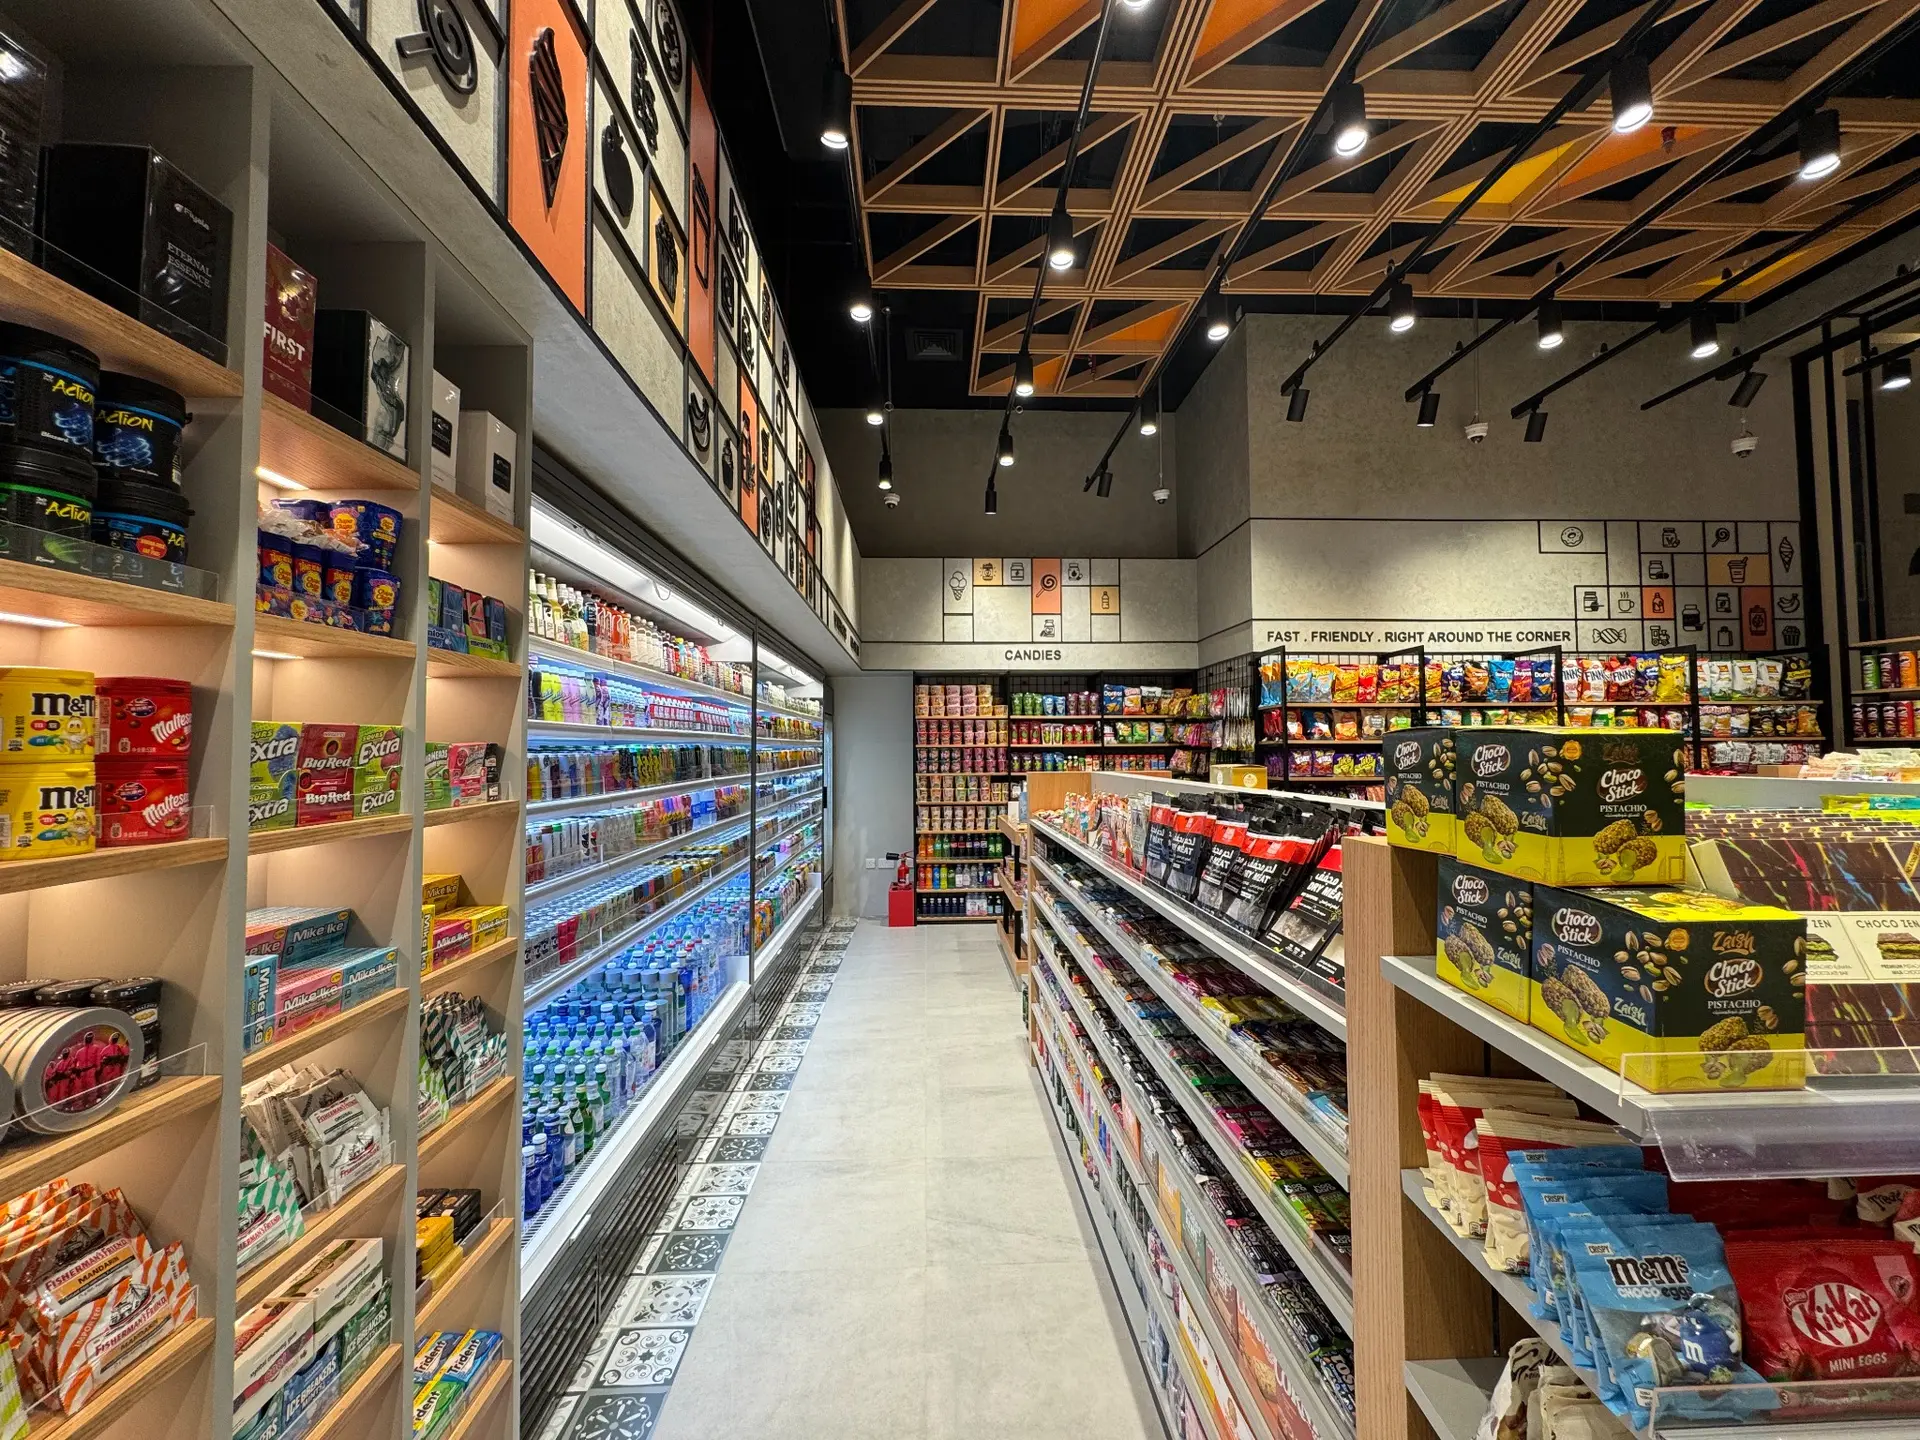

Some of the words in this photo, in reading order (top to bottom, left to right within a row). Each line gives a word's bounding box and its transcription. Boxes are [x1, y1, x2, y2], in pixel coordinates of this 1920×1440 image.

[167, 241, 212, 277] ETERNAL
[167, 254, 212, 288] ESSENCE
[263, 320, 305, 362] FIRST
[1267, 631, 1300, 643] FAST
[1311, 631, 1375, 643] FRIENDLY
[1385, 631, 1424, 643] RIGHT
[1428, 631, 1484, 643] AROUND
[1487, 631, 1512, 643] THE
[1516, 630, 1571, 643] CORNER
[1004, 649, 1062, 661] CANDIES
[1612, 669, 1636, 681] FINNS
[358, 737, 401, 766] Extra
[1397, 741, 1418, 758] Choco
[1475, 744, 1506, 764] Choco
[1397, 754, 1420, 771] Stick
[1477, 759, 1507, 778] Stick
[1398, 772, 1423, 780] PISTACHIO
[1476, 780, 1511, 791] PISTACHIO
[1600, 769, 1642, 788] Choco
[361, 789, 396, 814] Extra
[1605, 781, 1645, 802] Stick
[1600, 803, 1648, 813] PISTACHIO
[1252, 873, 1271, 885] MEAT
[1307, 881, 1323, 894] DRY
[1455, 875, 1485, 890] Choco
[1457, 889, 1485, 905] Stick
[1456, 906, 1488, 924] PISTACHIO
[1556, 907, 1597, 927] Choco
[1811, 919, 1832, 929] ZEN
[1856, 919, 1899, 929] CHOCO
[293, 926, 325, 943] Mike
[327, 921, 344, 934] Ike
[1559, 924, 1597, 944] Stick
[262, 940, 281, 954] Ike
[1711, 930, 1756, 956] Zaish
[1557, 944, 1601, 968] PISTACHIO
[349, 968, 377, 985] Mike
[1709, 959, 1756, 982] Choco
[257, 965, 272, 1013] Mike
[1713, 975, 1758, 998] Stick
[283, 991, 319, 1015] Mike
[1613, 997, 1647, 1027] Zaish
[1707, 1000, 1761, 1010] PISTACHIO
[1526, 1153, 1546, 1161] CRISPY
[1544, 1194, 1565, 1203] CRISPY
[1588, 1244, 1609, 1254] CRISPY
[45, 1251, 105, 1291] FISHERMAN'S
[102, 1237, 128, 1255] FRIEND
[77, 1255, 120, 1285] MANDARIN
[1607, 1255, 1690, 1286] m&m's
[1617, 1286, 1660, 1298] CHOCO
[1661, 1286, 1693, 1301] eggs
[75, 1306, 101, 1348] IMPORTED
[94, 1313, 147, 1357] FISHERMAN'S
[414, 1341, 447, 1375] Trident
[446, 1338, 480, 1375] Trident
[1829, 1357, 1855, 1373] MINI
[1858, 1352, 1888, 1366] EGGS
[286, 1396, 301, 1421] ICE
[299, 1357, 337, 1399] BREAKERS
